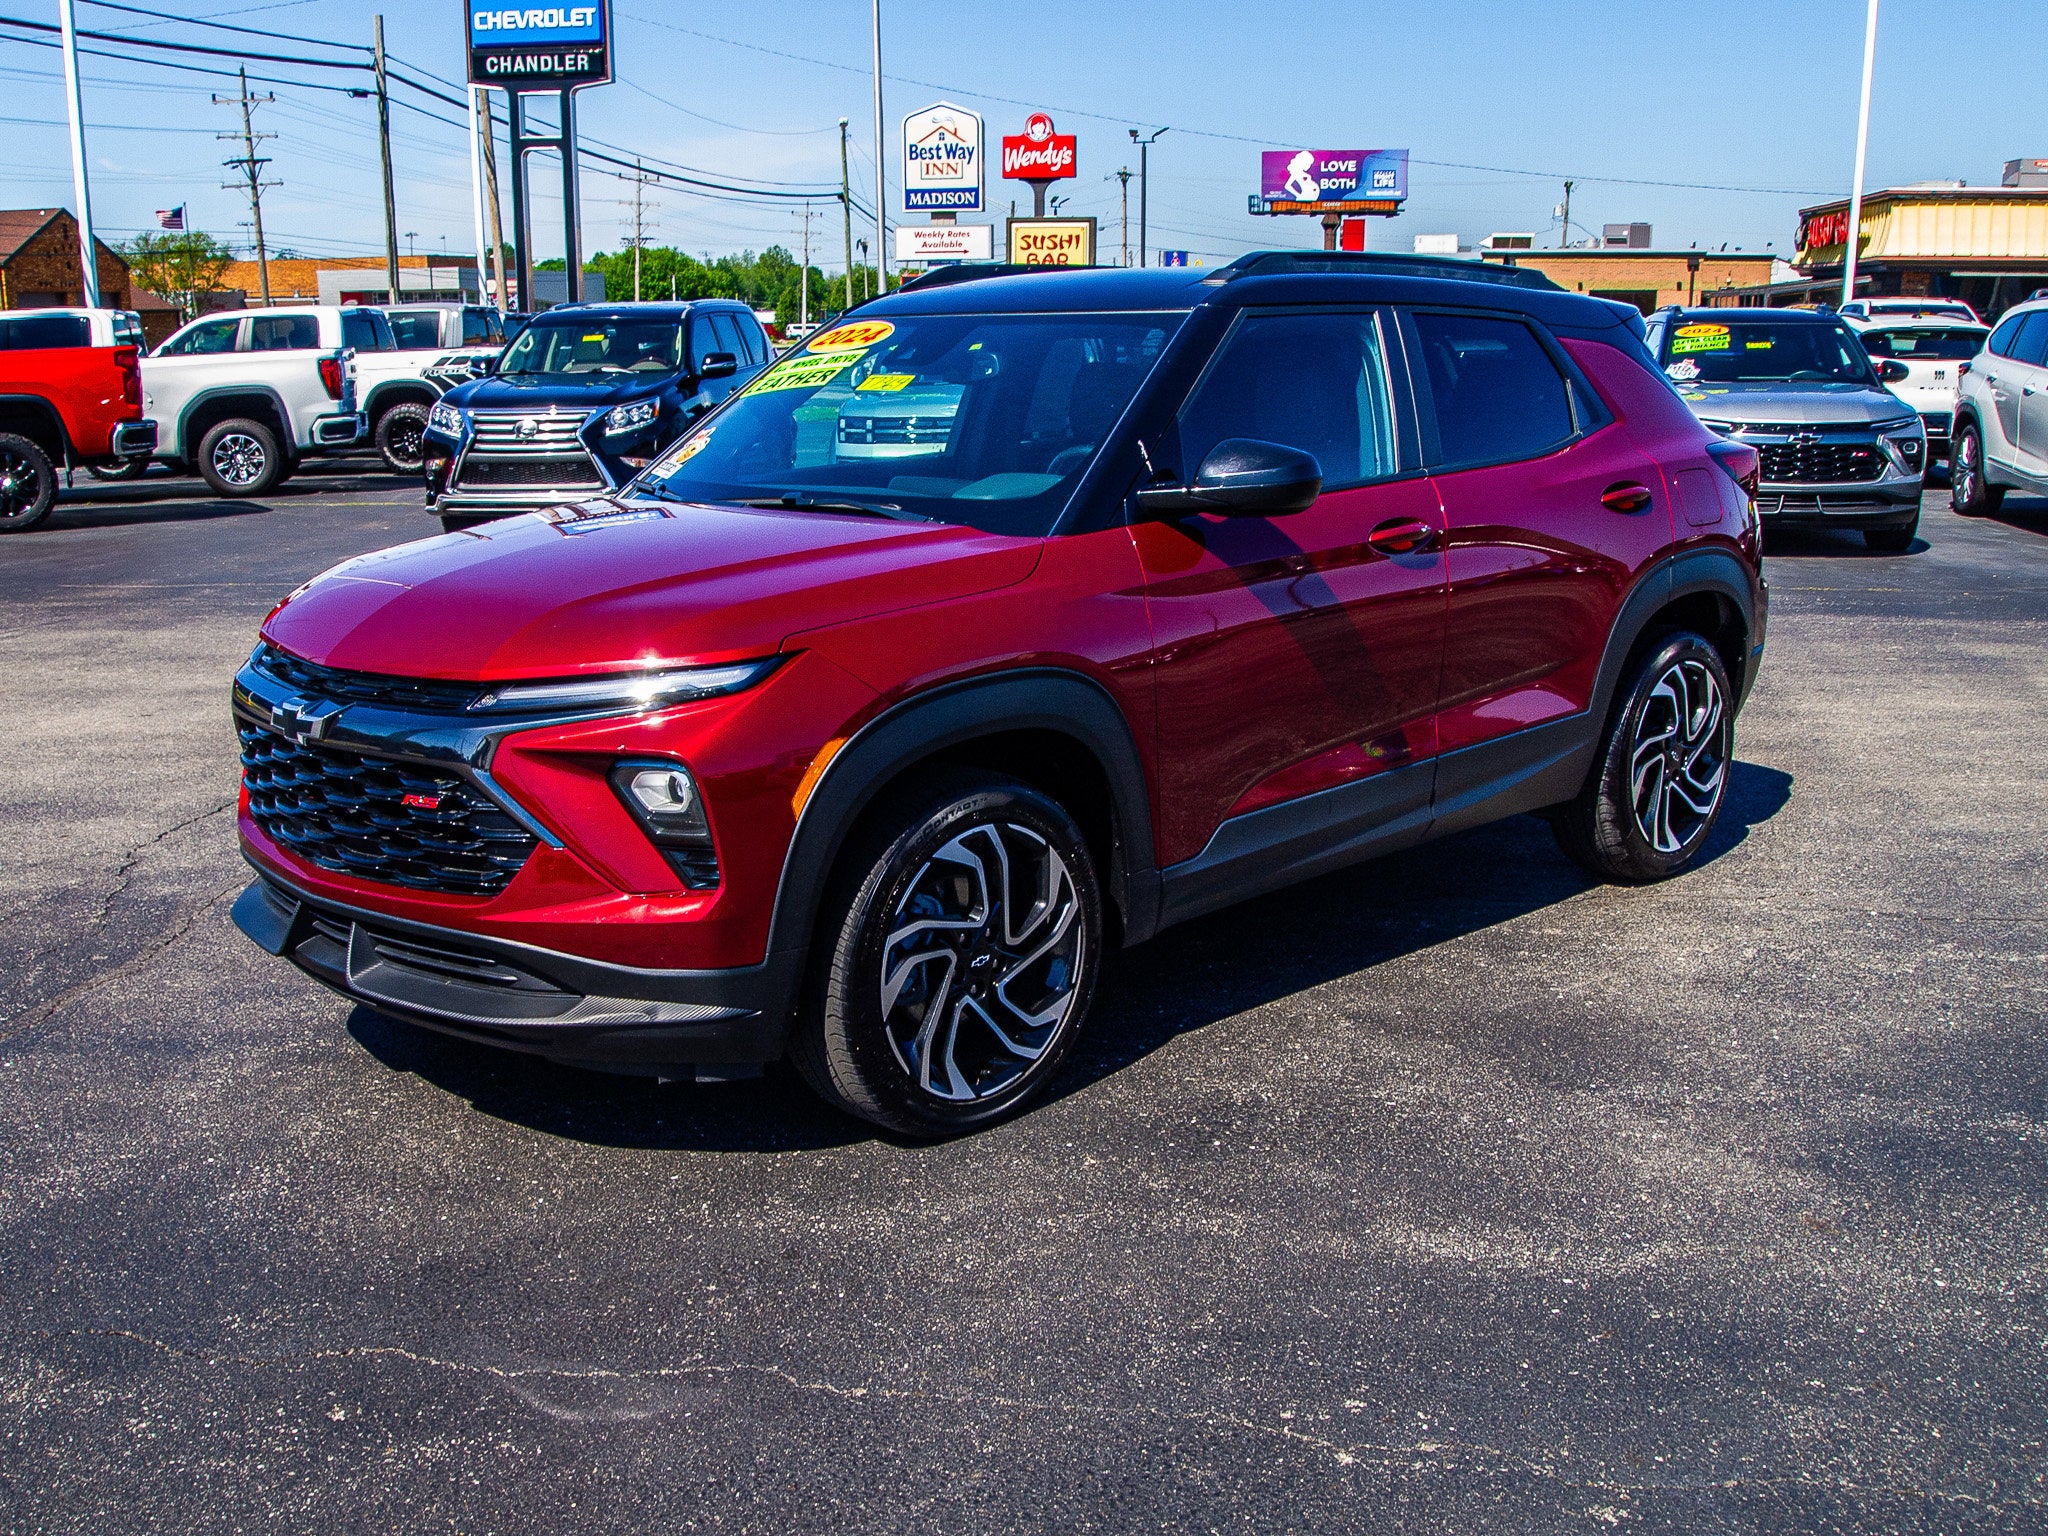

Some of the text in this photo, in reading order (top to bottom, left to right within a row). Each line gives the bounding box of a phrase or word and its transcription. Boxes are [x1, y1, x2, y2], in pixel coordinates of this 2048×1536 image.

[474, 8, 596, 30] CHEVROLET
[486, 54, 589, 73] CHANDLER
[909, 142, 975, 165] Best Way
[1004, 142, 1073, 172] Wendy's
[925, 162, 959, 175] INN
[1320, 160, 1357, 173] LOVE
[1320, 178, 1356, 190] BOTH
[1373, 179, 1395, 188] LIFE
[909, 191, 975, 206] MADISON
[914, 230, 970, 240] Weekly Rates
[1020, 234, 1081, 251] SUSHI
[921, 240, 963, 249] Available
[1026, 252, 1069, 265] BAR
[815, 327, 889, 347] 2024
[1682, 327, 1723, 336] 2024
[748, 368, 837, 394] LEATHER
[402, 793, 439, 809] RS
